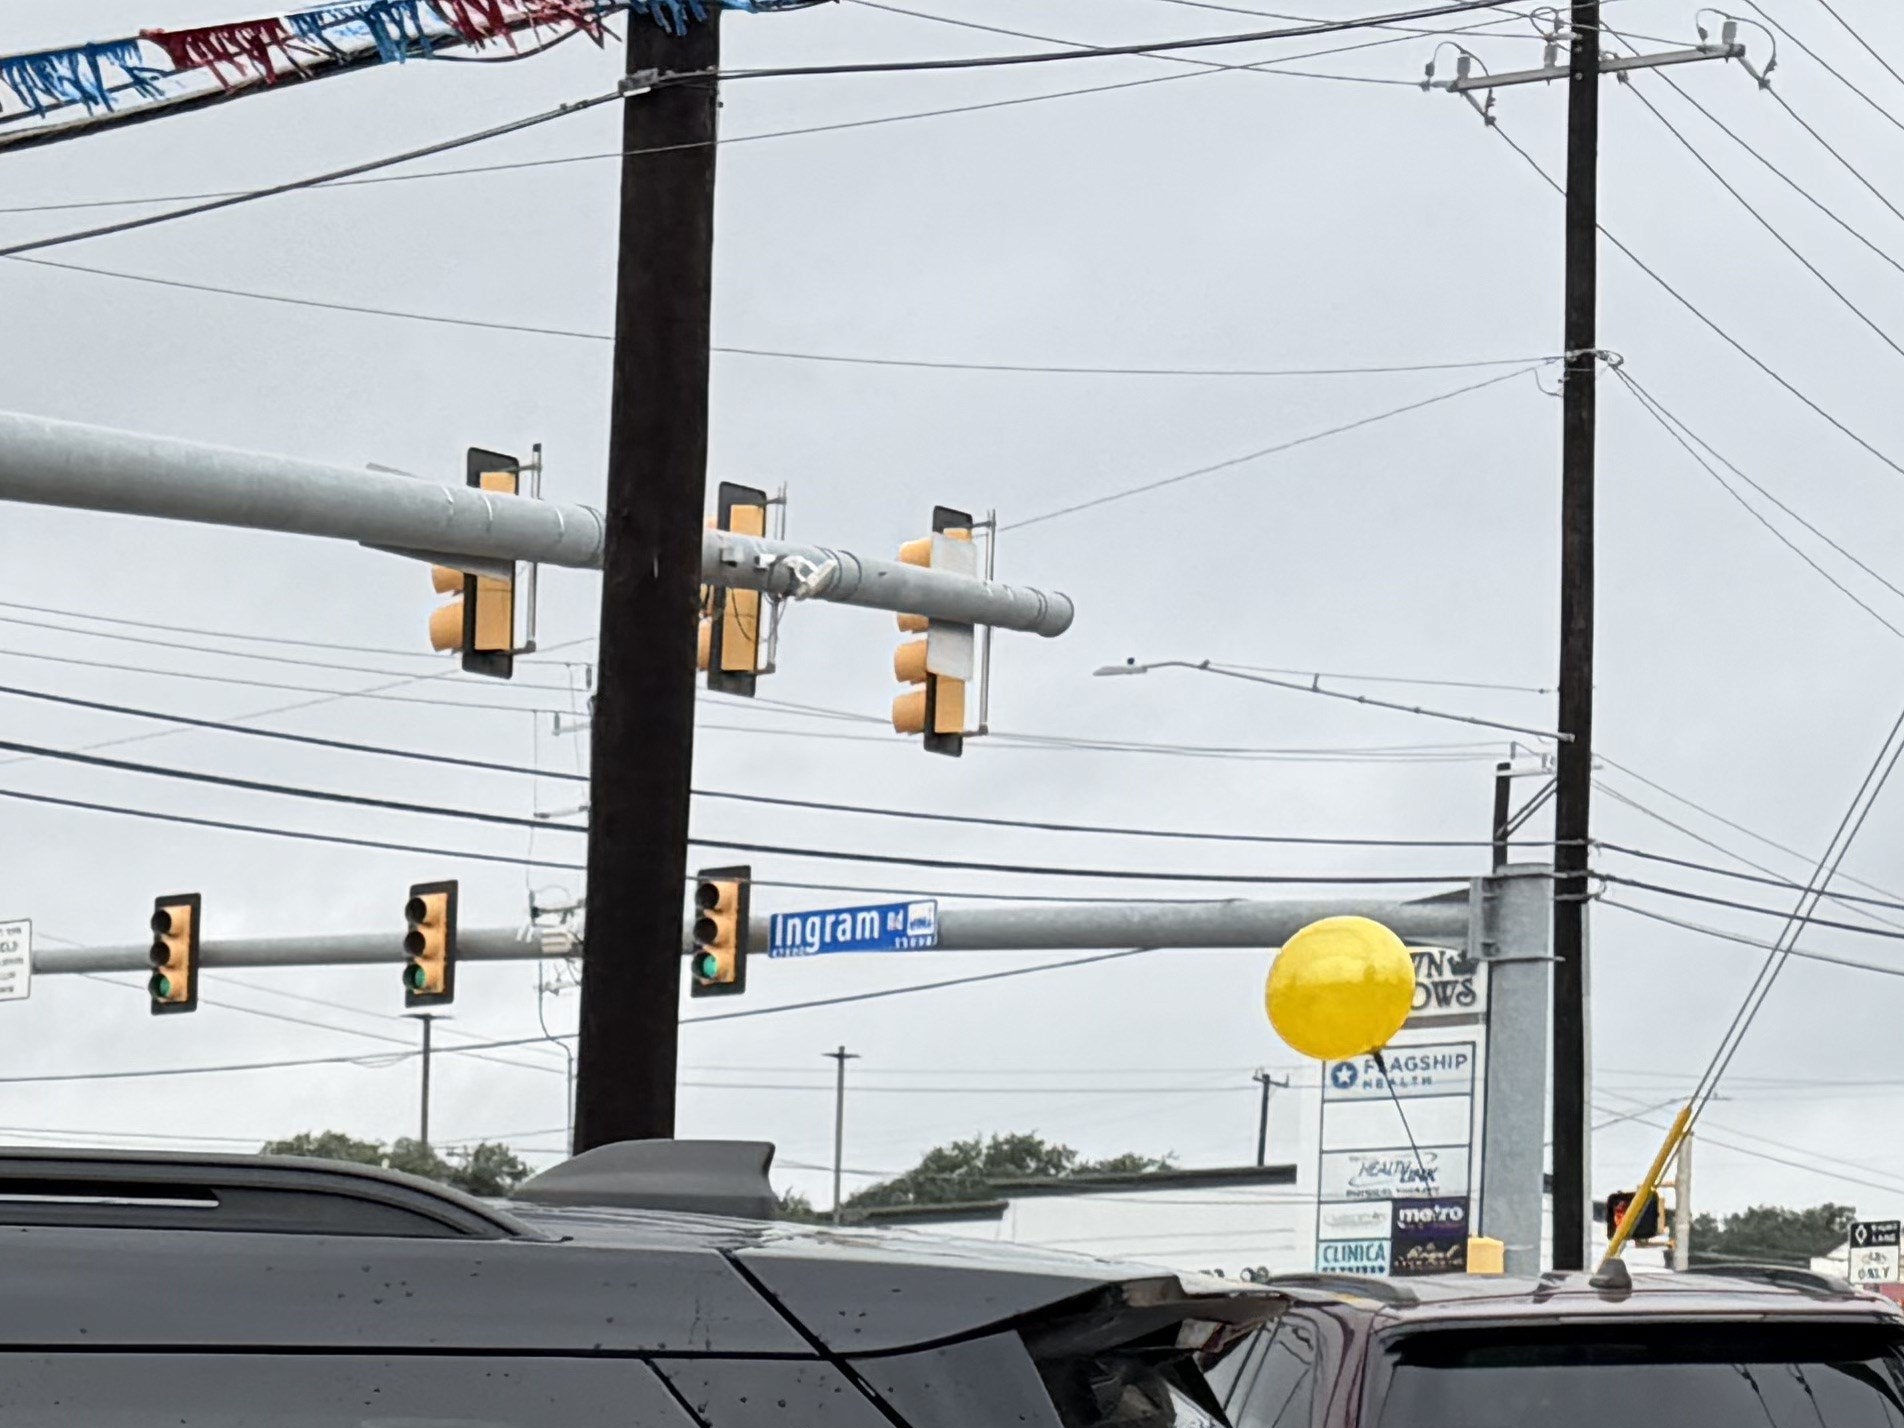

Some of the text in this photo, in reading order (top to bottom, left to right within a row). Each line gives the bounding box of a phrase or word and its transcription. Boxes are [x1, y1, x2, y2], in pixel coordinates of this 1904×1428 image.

[774, 910, 880, 953] Ingram
[1363, 1053, 1468, 1074] FAGSHIP
[1398, 1204, 1464, 1224] metro
[1323, 1243, 1386, 1265] CLINICA
